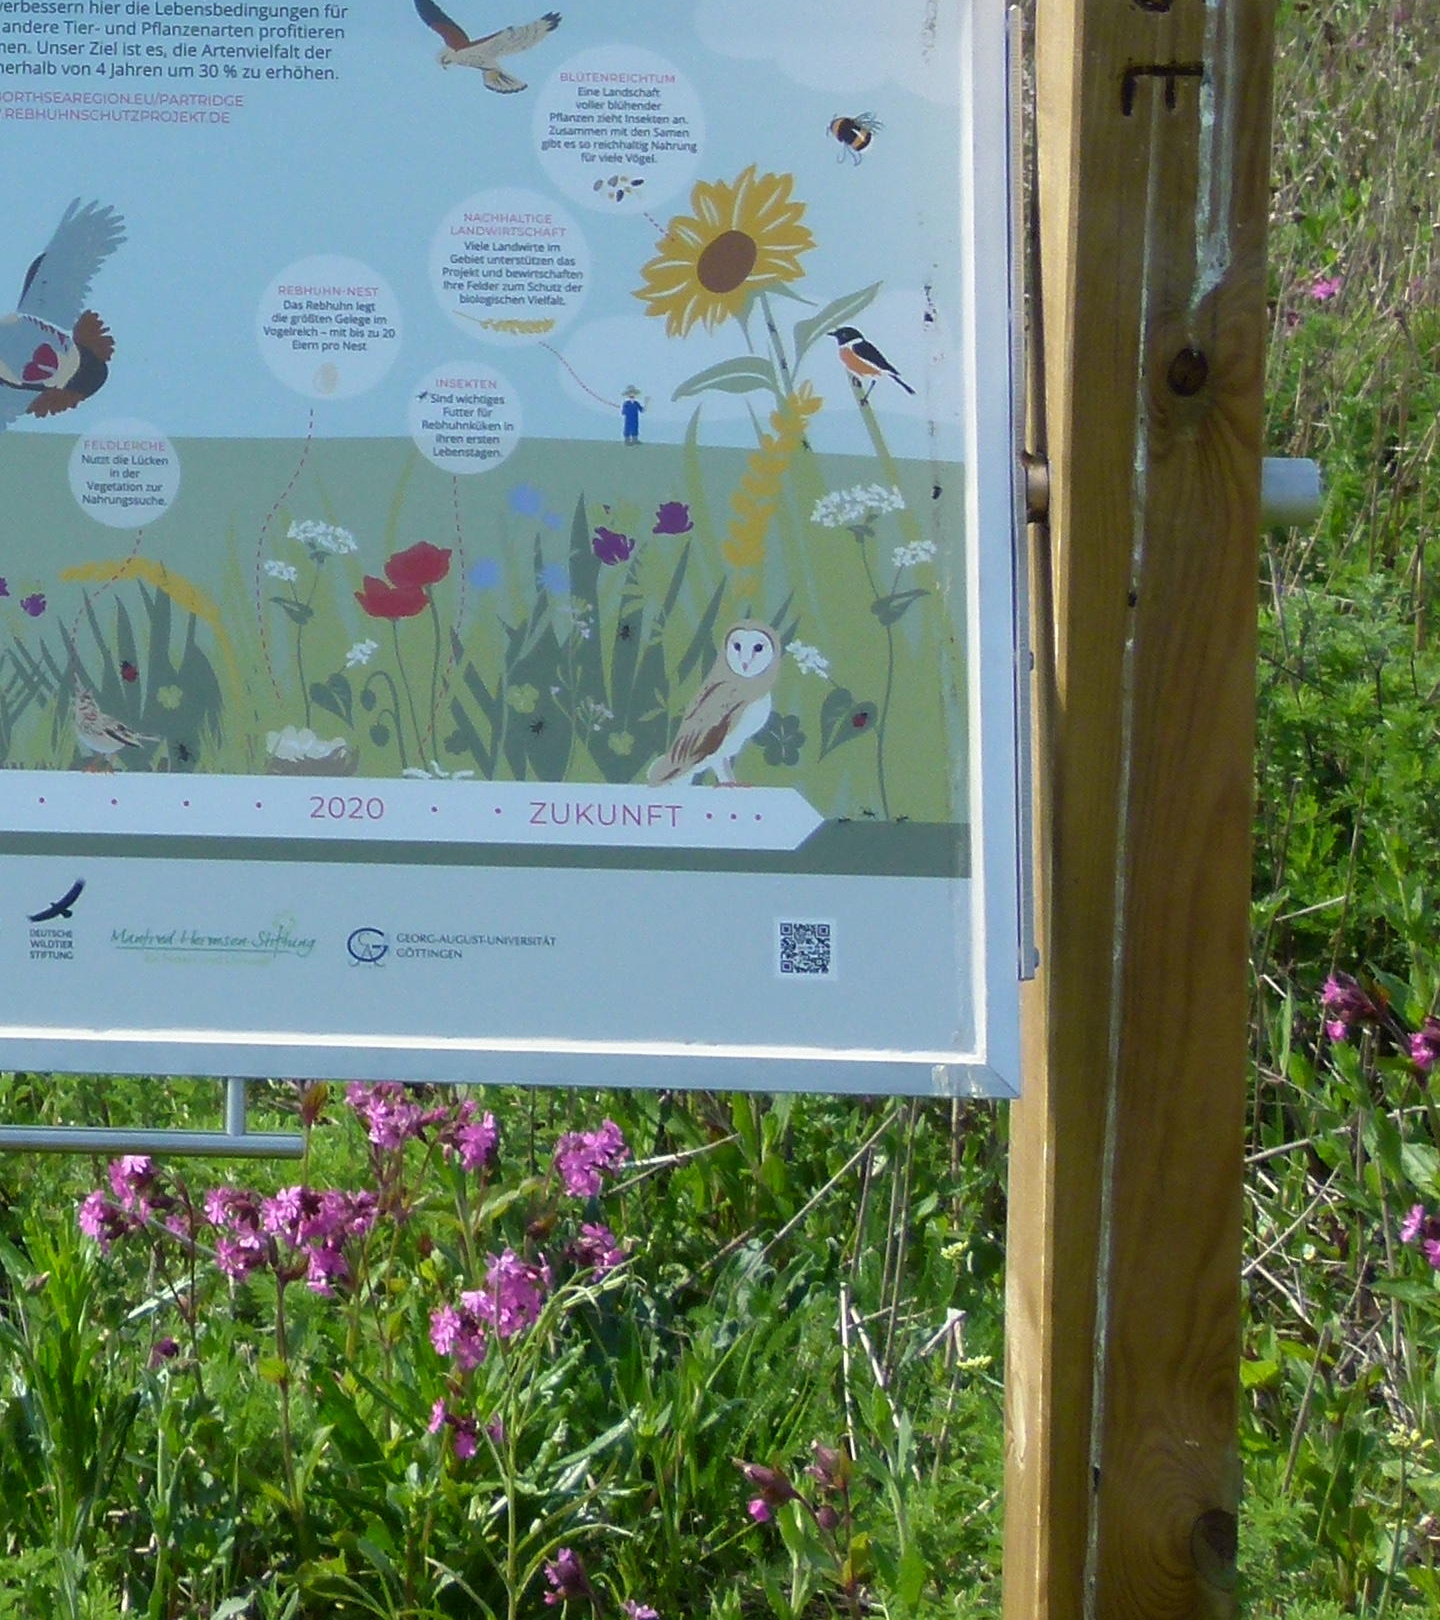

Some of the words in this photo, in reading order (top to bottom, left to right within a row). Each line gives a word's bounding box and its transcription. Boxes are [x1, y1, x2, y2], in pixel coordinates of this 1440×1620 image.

[89, 0, 120, 14] hier
[125, 0, 149, 15] die
[155, 1, 319, 21] Lebensbedingungen
[324, 4, 347, 18] für
[1, 18, 58, 34] andere
[63, 19, 99, 34] Tier-
[104, 20, 135, 35] und
[141, 21, 253, 37] Pflanzenarten
[258, 23, 345, 42] profitieren
[36, 40, 84, 55] Unser
[89, 40, 117, 55] Ziel
[122, 41, 141, 56] ist
[145, 45, 166, 60] es,
[172, 42, 196, 57] die
[201, 42, 299, 58] Artenvielfalt
[304, 44, 332, 59] der
[61, 64, 90, 75] von
[95, 61, 105, 75] 4
[110, 61, 162, 80] Jahren
[167, 66, 193, 77] um
[199, 63, 218, 78] 30
[223, 63, 237, 78] %
[242, 67, 260, 78] zu
[265, 64, 339, 80] erhöhen.
[309, 796, 385, 820] 2020
[528, 801, 684, 828] ZUKUNFT
[396, 946, 463, 959] GÖTTINGEN
